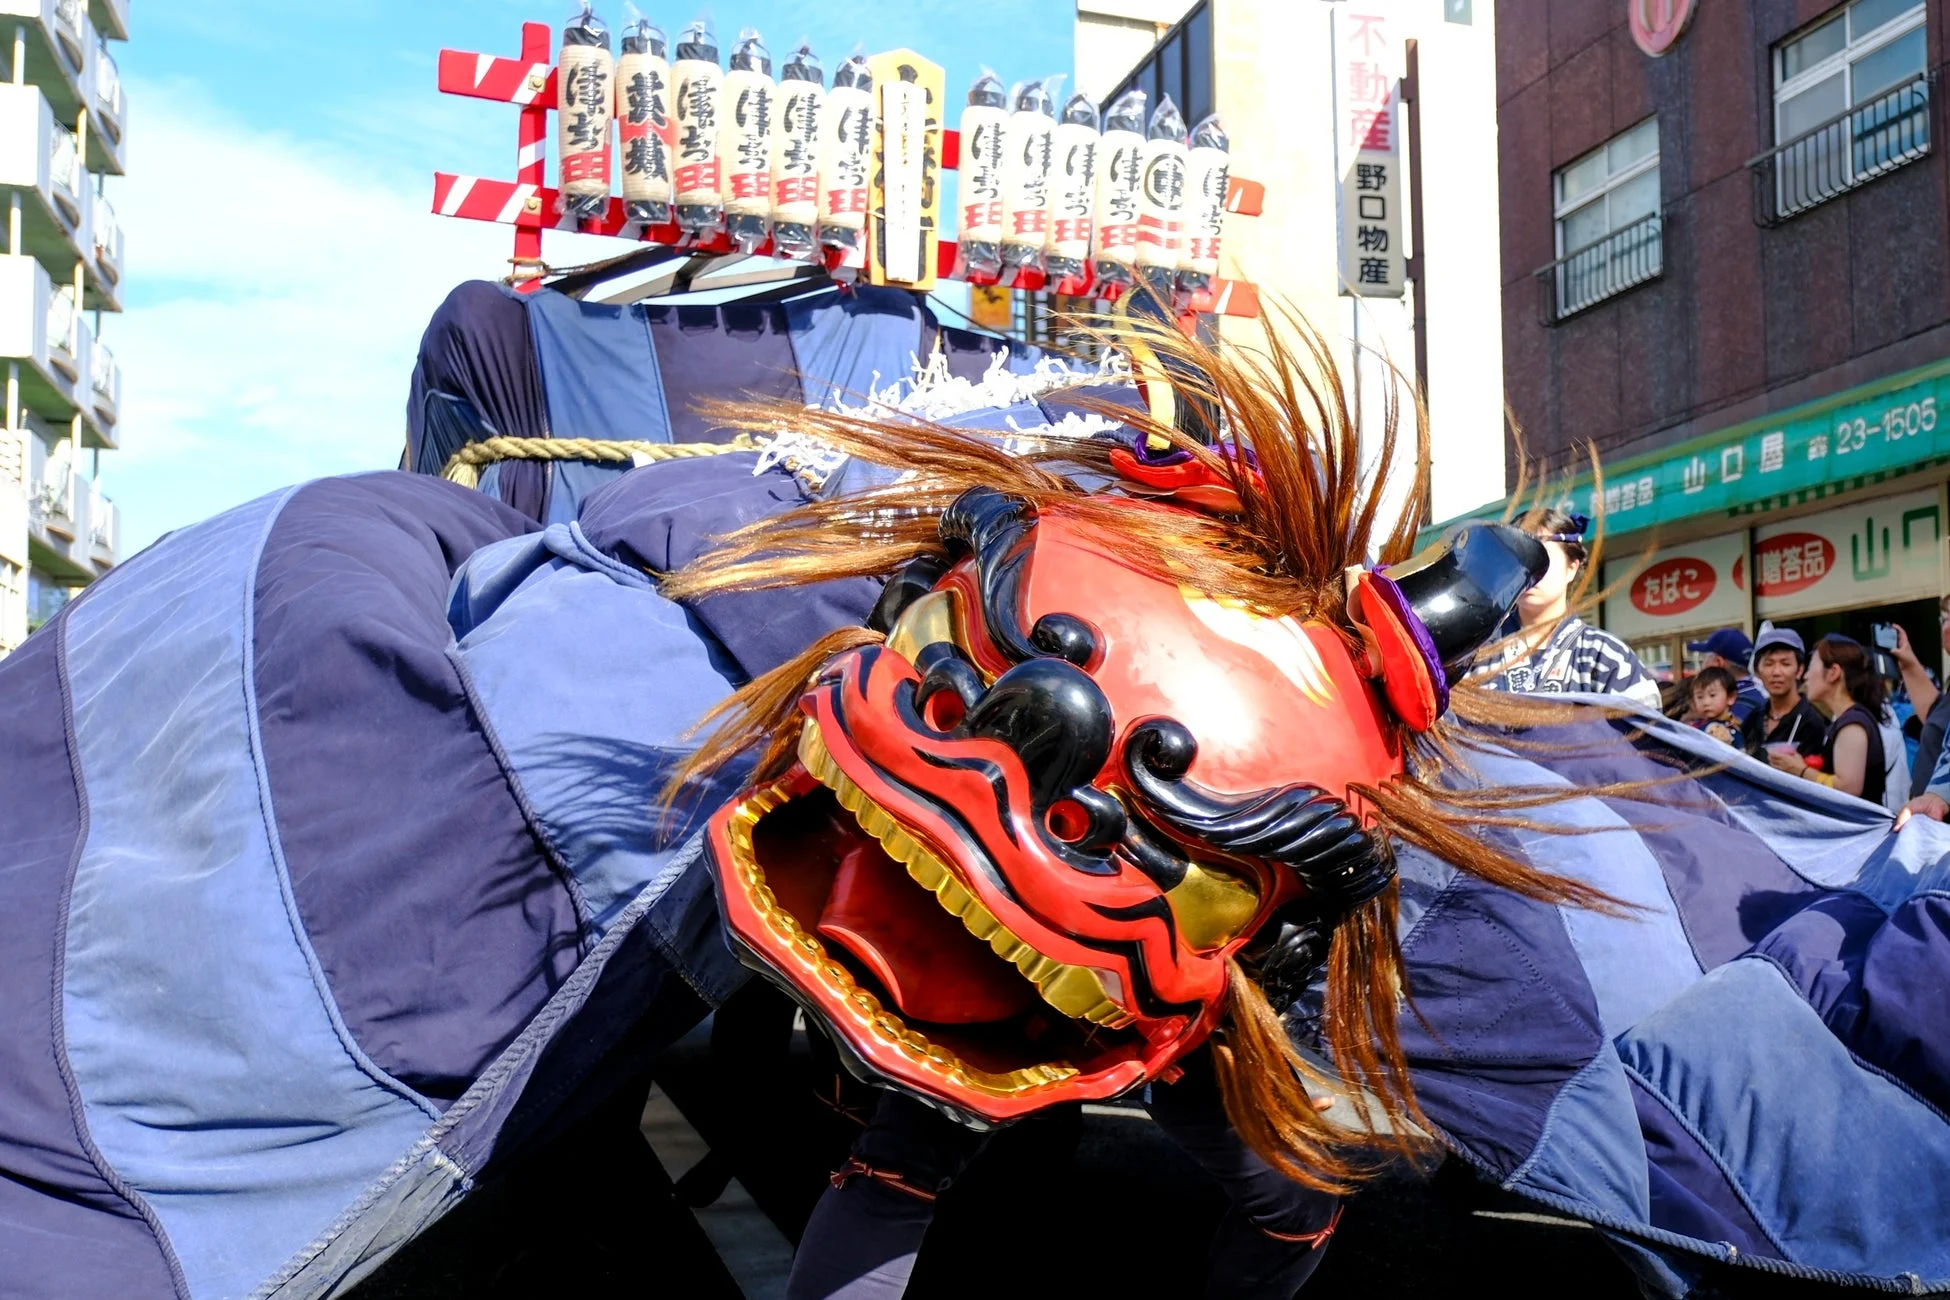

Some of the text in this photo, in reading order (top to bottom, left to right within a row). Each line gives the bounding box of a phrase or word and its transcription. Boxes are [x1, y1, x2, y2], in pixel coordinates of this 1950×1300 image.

[1348, 13, 1391, 151] 不動産
[1356, 163, 1390, 285] 野口物産
[1683, 431, 1784, 494] 山口屋
[1836, 397, 1937, 454] 23-1505
[1755, 540, 1826, 586] 贈答品
[1852, 505, 1940, 582] 山口
[1643, 568, 1701, 609] たばこ
